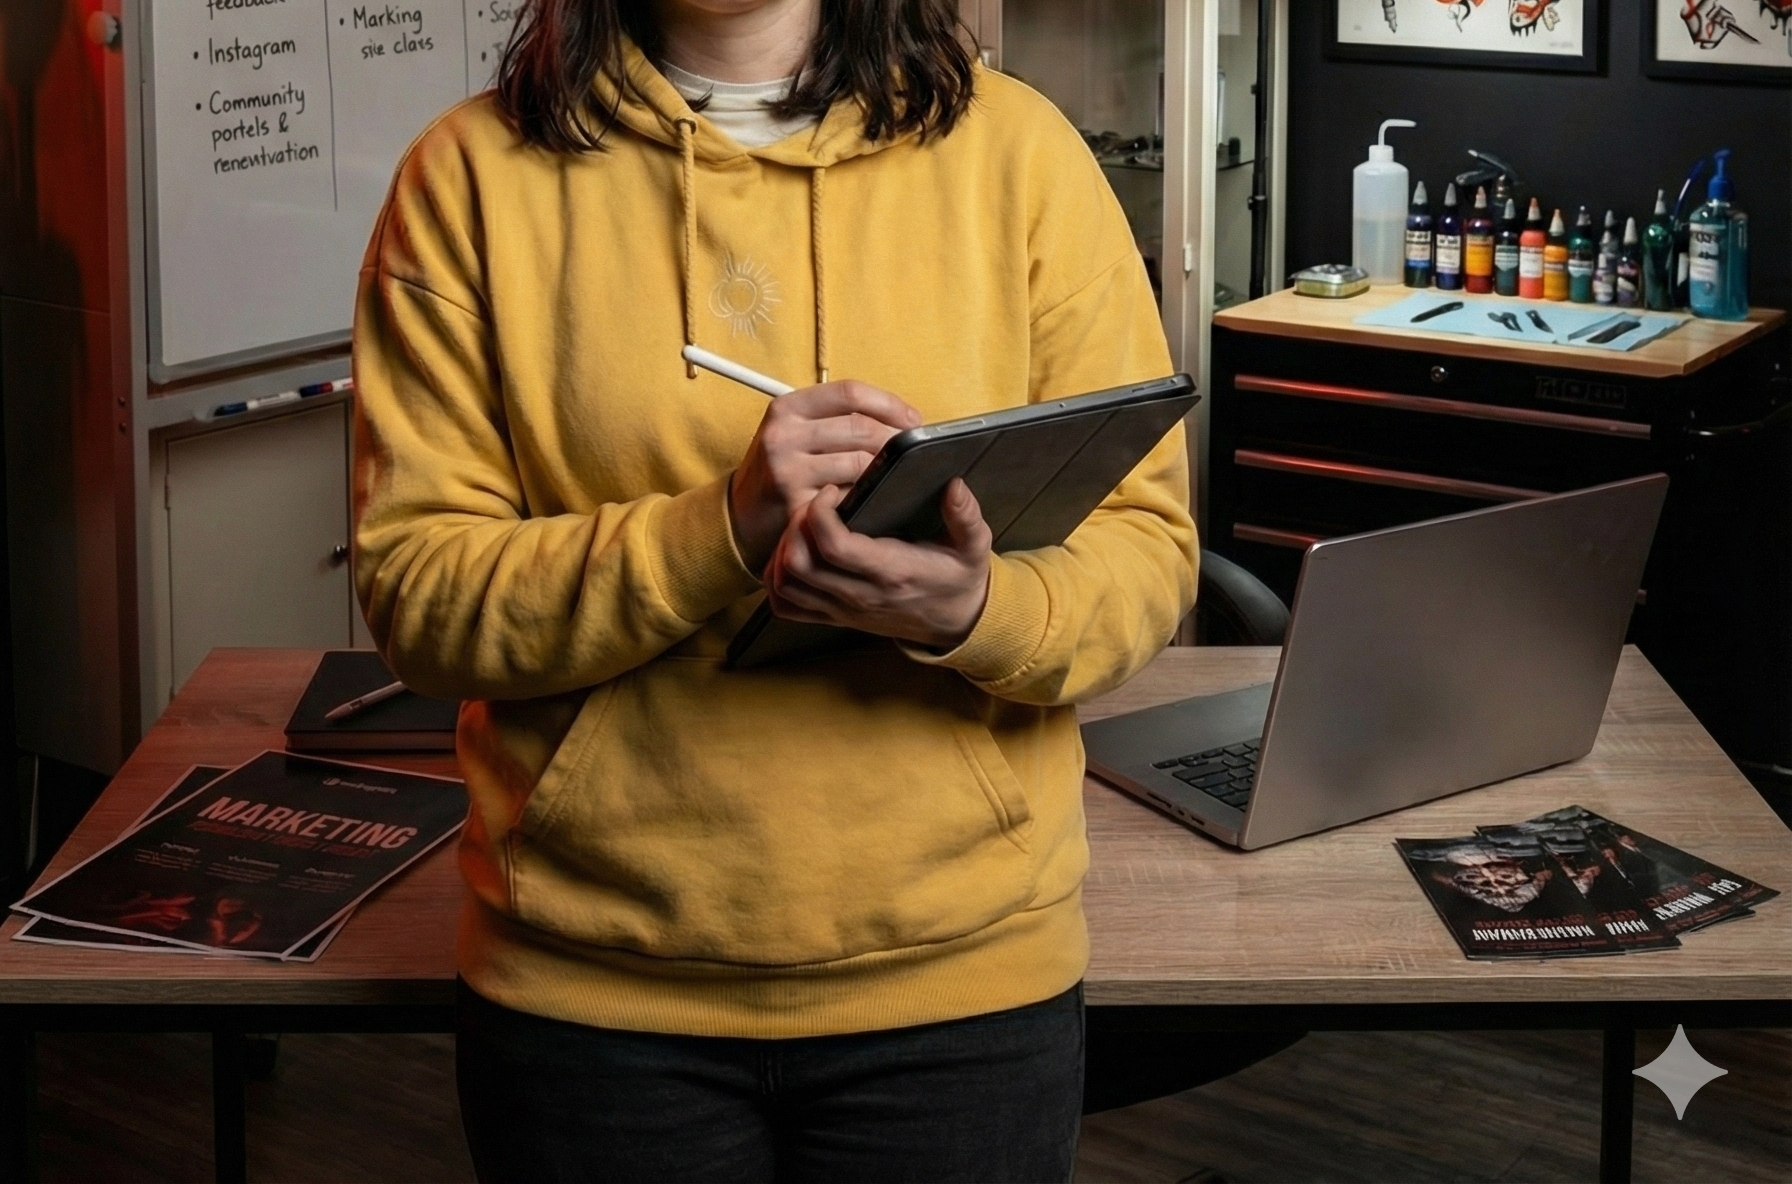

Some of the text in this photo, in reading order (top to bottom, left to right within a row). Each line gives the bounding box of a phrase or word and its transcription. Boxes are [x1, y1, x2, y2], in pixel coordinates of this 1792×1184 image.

[353, 4, 423, 34] Marking
[209, 37, 296, 70] Instagram
[209, 81, 306, 115] Community
[212, 111, 289, 152] portels &
[197, 796, 419, 849] MARKETING
